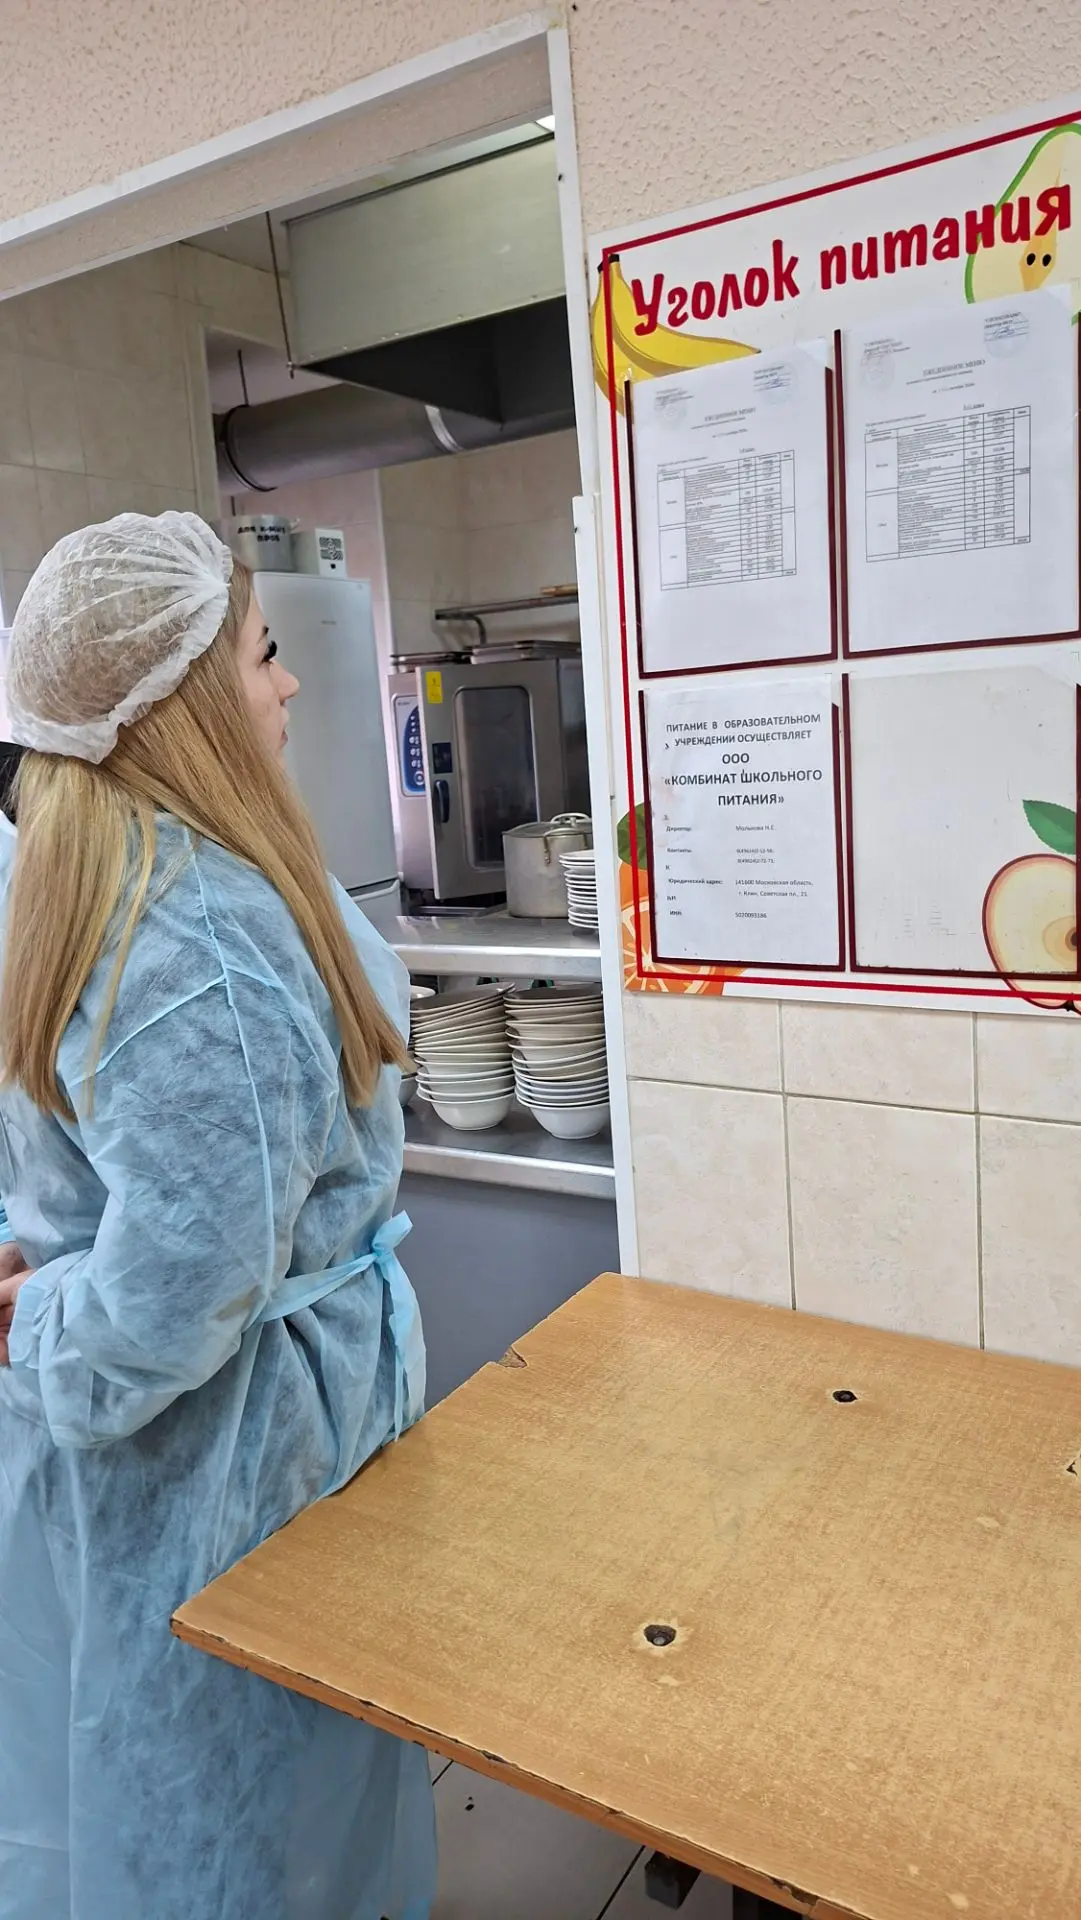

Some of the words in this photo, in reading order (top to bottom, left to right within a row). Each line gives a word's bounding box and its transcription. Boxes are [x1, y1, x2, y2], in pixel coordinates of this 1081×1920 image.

[631, 240, 799, 336] Уголок
[820, 184, 1071, 290] питания
[666, 721, 708, 733] ПИТАНИЕ
[712, 721, 718, 729] В
[724, 714, 821, 729] ОБРАЗОВАТЕЛЬНОМ
[675, 734, 736, 747] УЧРЕЖДЕНИИ
[737, 730, 812, 743] ОСУЩЕСТВЛЯЕТ
[722, 753, 750, 764] ООО
[664, 773, 737, 786] «КОМБИНАТ
[740, 769, 822, 783] ШКОЛЬНОГО
[718, 793, 785, 806] ПИТАНИЯ»
